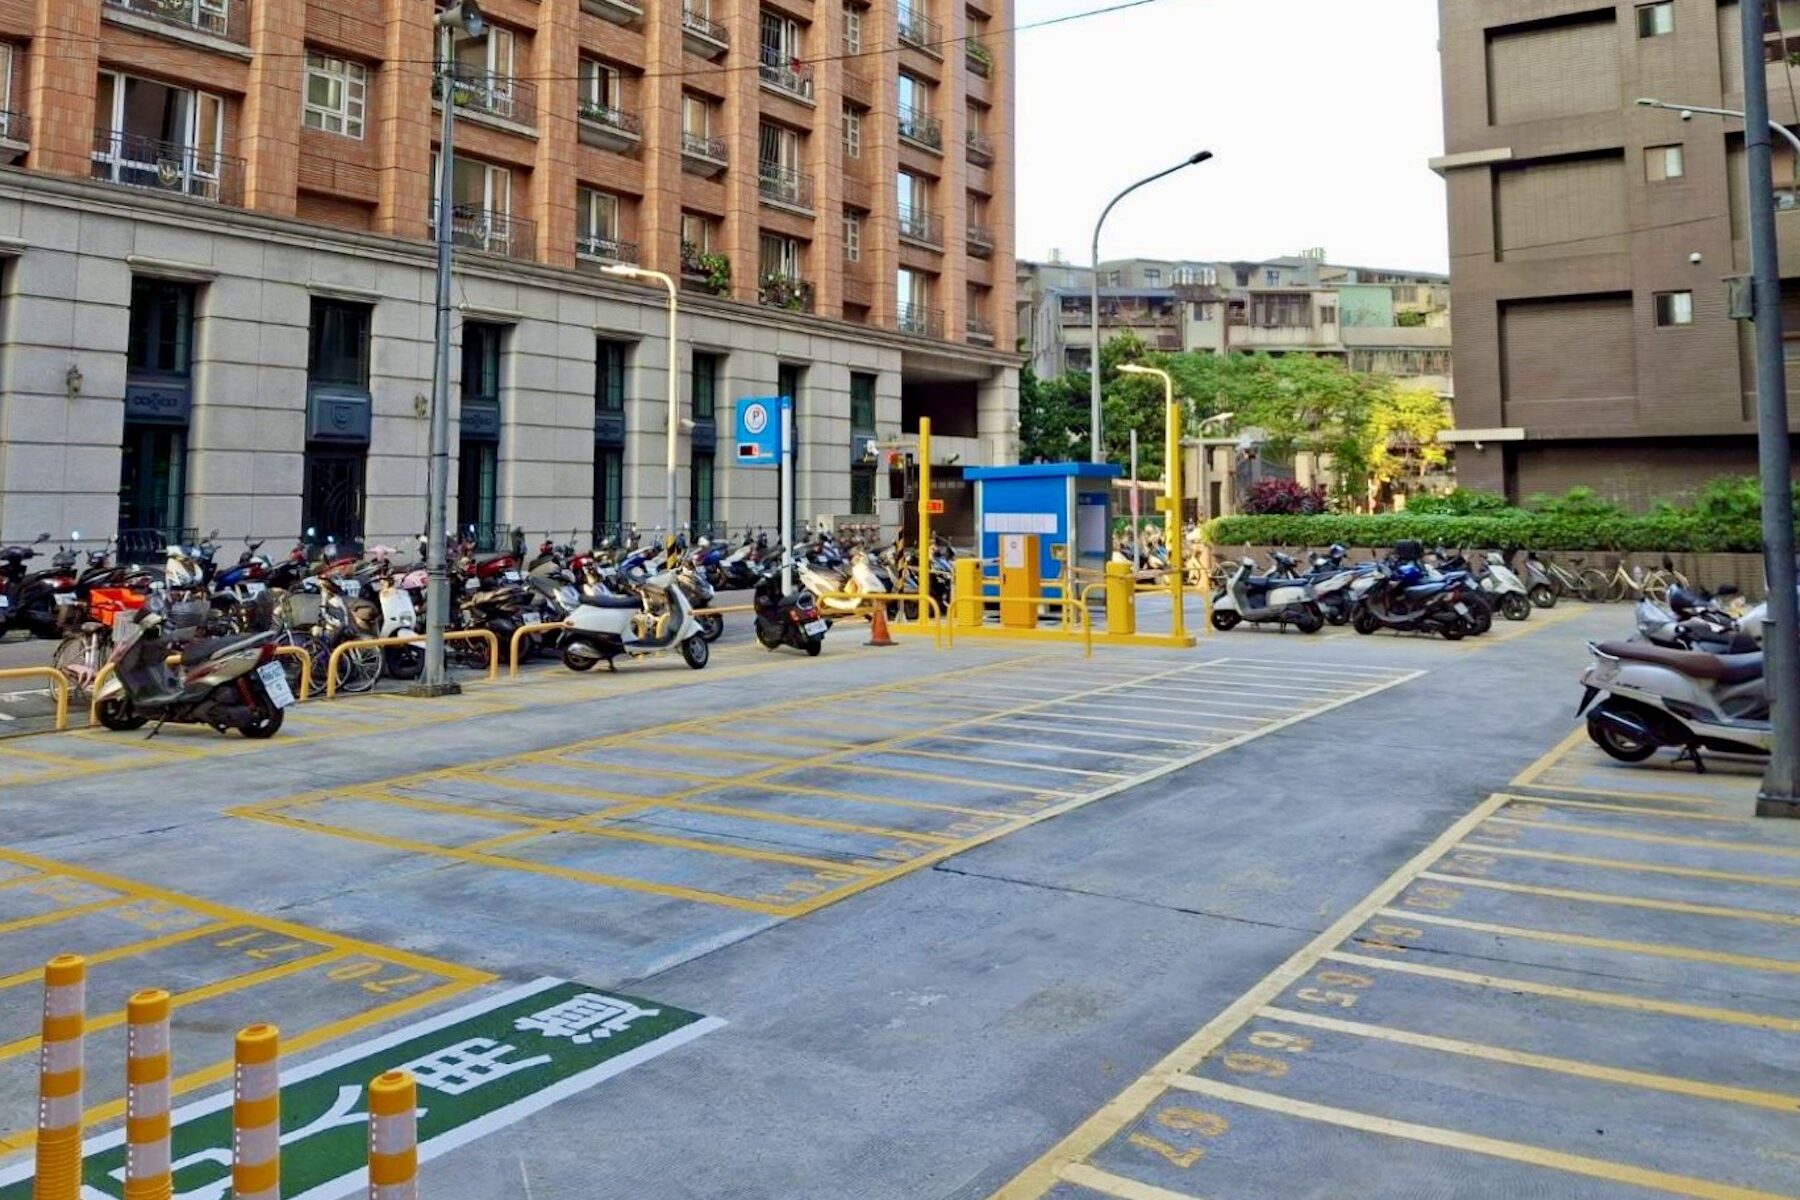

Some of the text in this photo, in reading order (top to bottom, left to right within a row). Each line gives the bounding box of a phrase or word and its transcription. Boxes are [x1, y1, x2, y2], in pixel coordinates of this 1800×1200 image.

[215, 930, 302, 960] 71
[327, 961, 423, 993] 70
[1296, 970, 1375, 1009] 65
[1222, 1029, 1313, 1079] 66
[1127, 1105, 1231, 1169] 67
